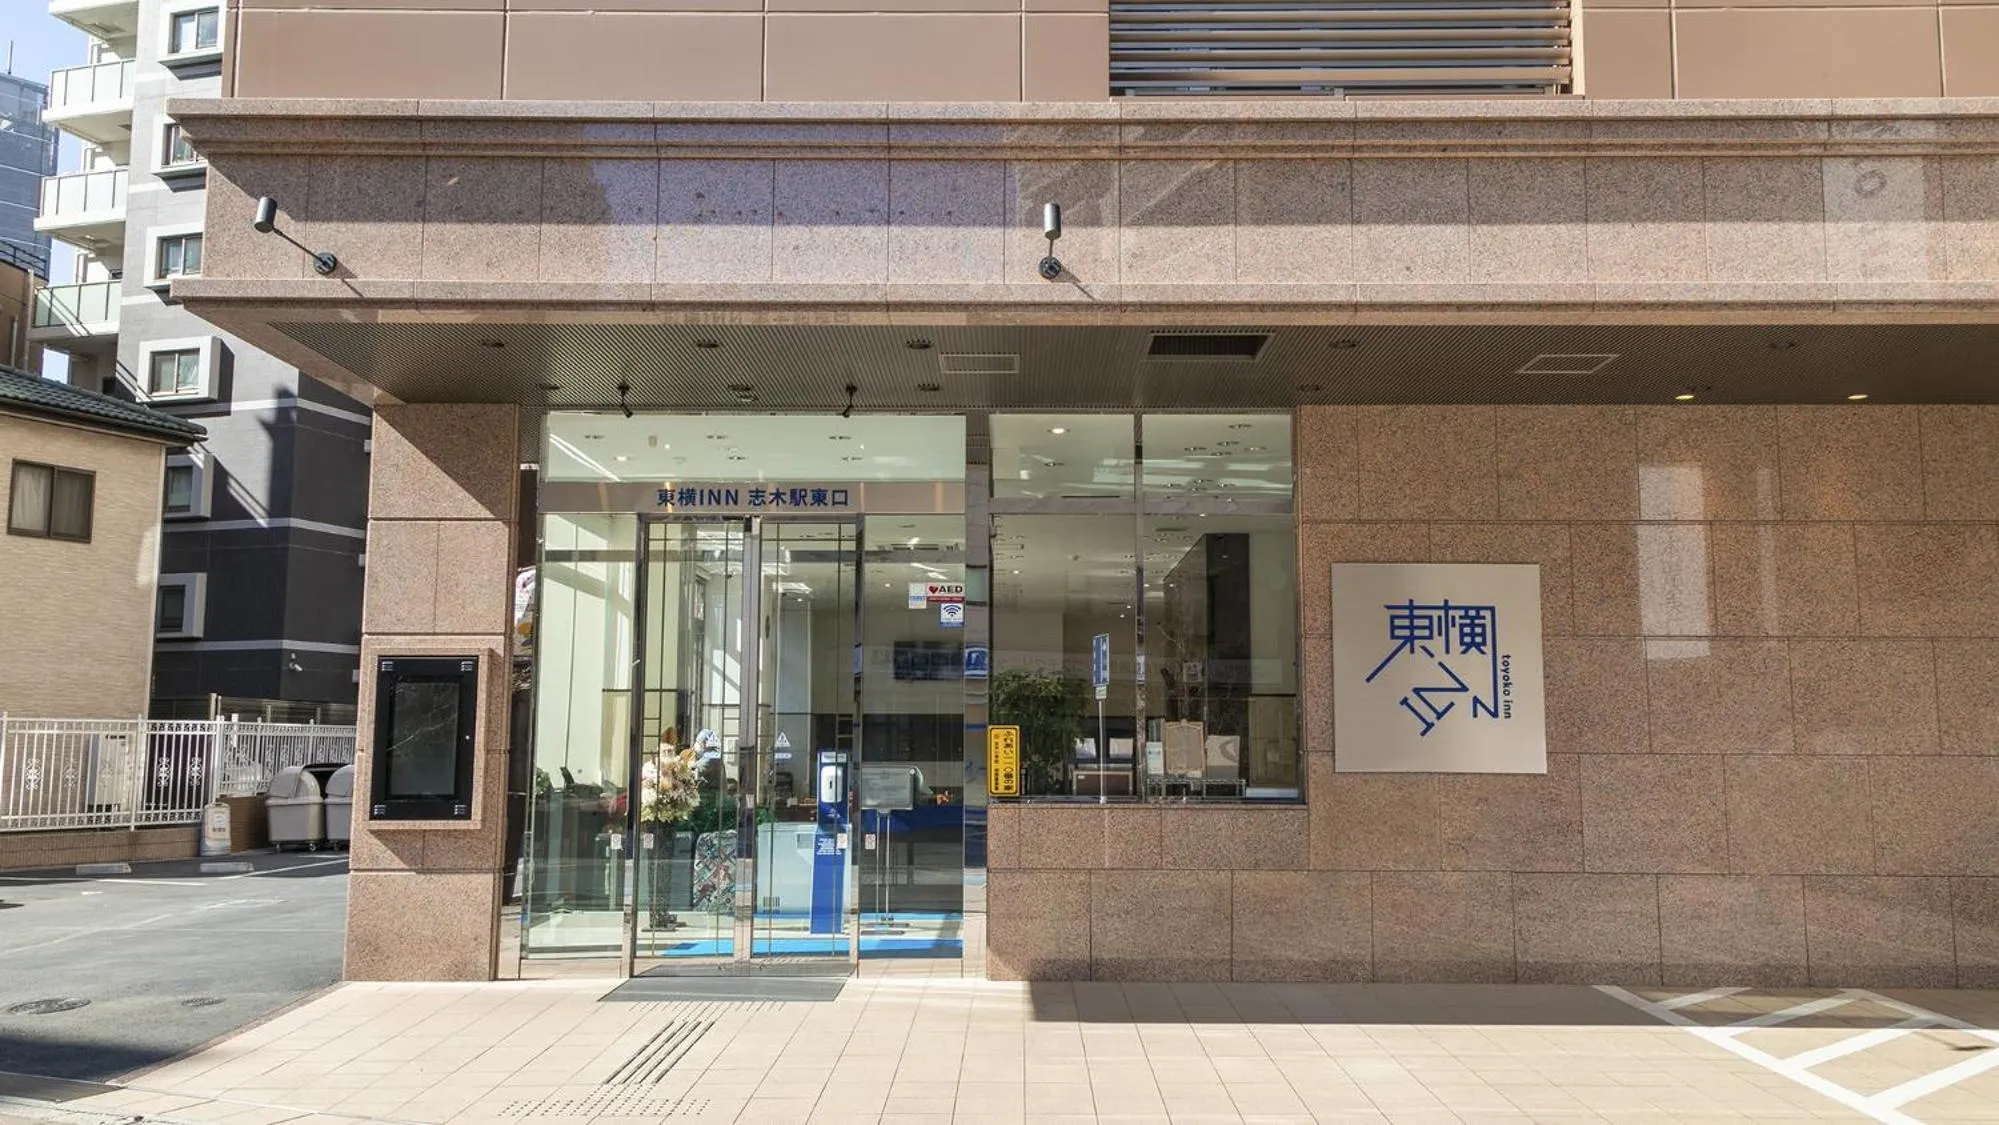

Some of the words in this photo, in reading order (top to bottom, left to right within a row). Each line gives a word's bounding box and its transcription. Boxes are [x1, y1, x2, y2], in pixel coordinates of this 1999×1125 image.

[657, 487, 739, 507] 東横INN
[748, 487, 849, 507] 志木駅東口
[939, 585, 963, 593] AED
[1500, 654, 1512, 696] toyoko
[1503, 700, 1513, 719] inn
